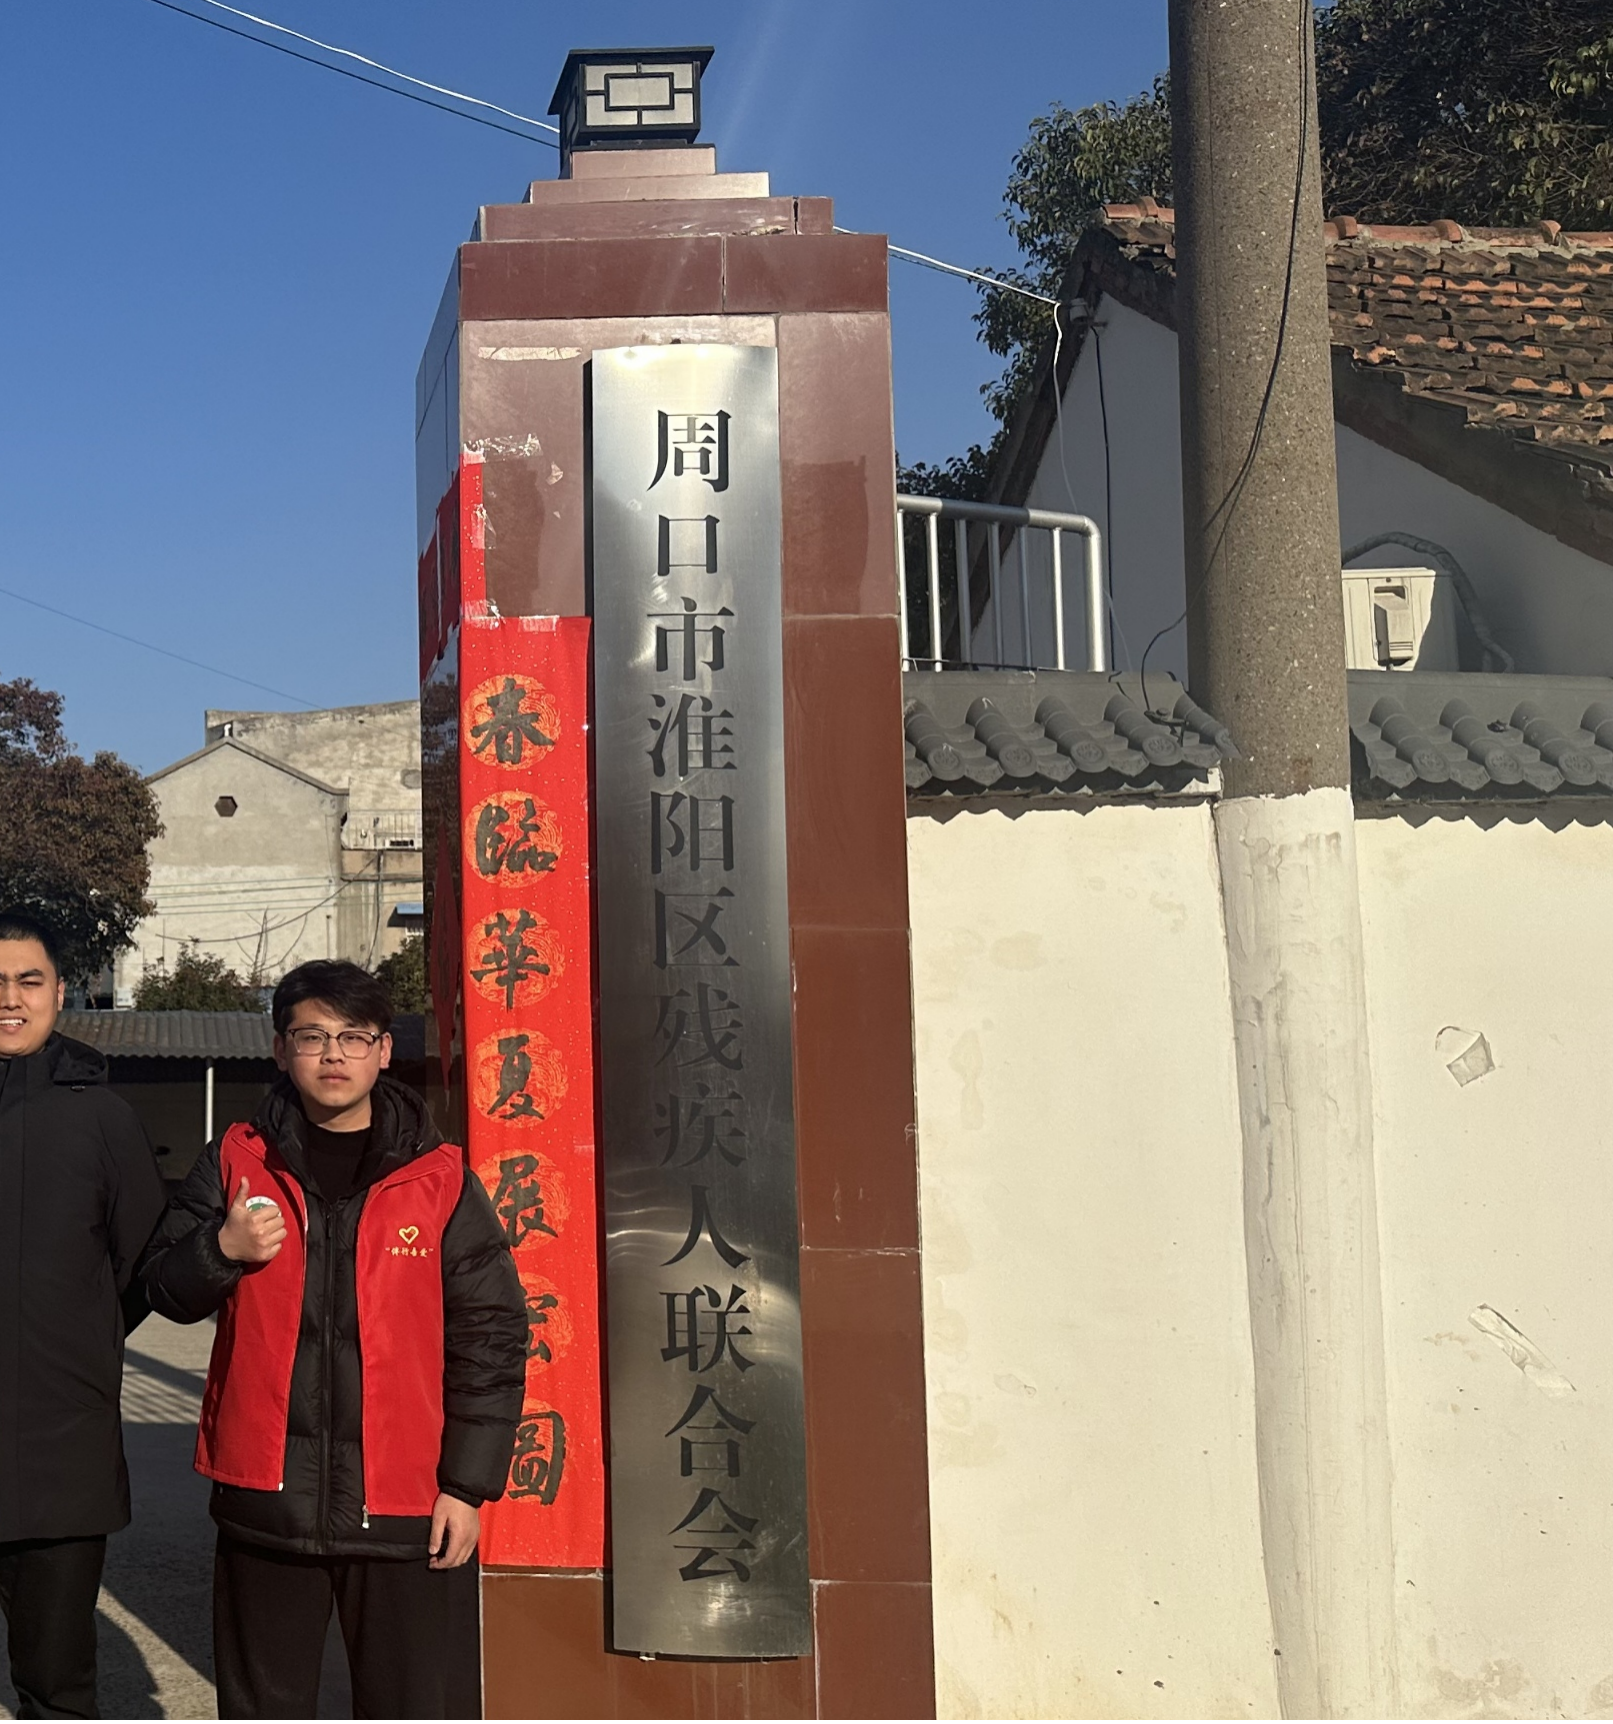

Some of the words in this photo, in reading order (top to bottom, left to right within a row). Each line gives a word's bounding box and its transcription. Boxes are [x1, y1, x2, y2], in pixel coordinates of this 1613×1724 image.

[646, 408, 761, 1583] 周口市淮阳区残疾人联合会
